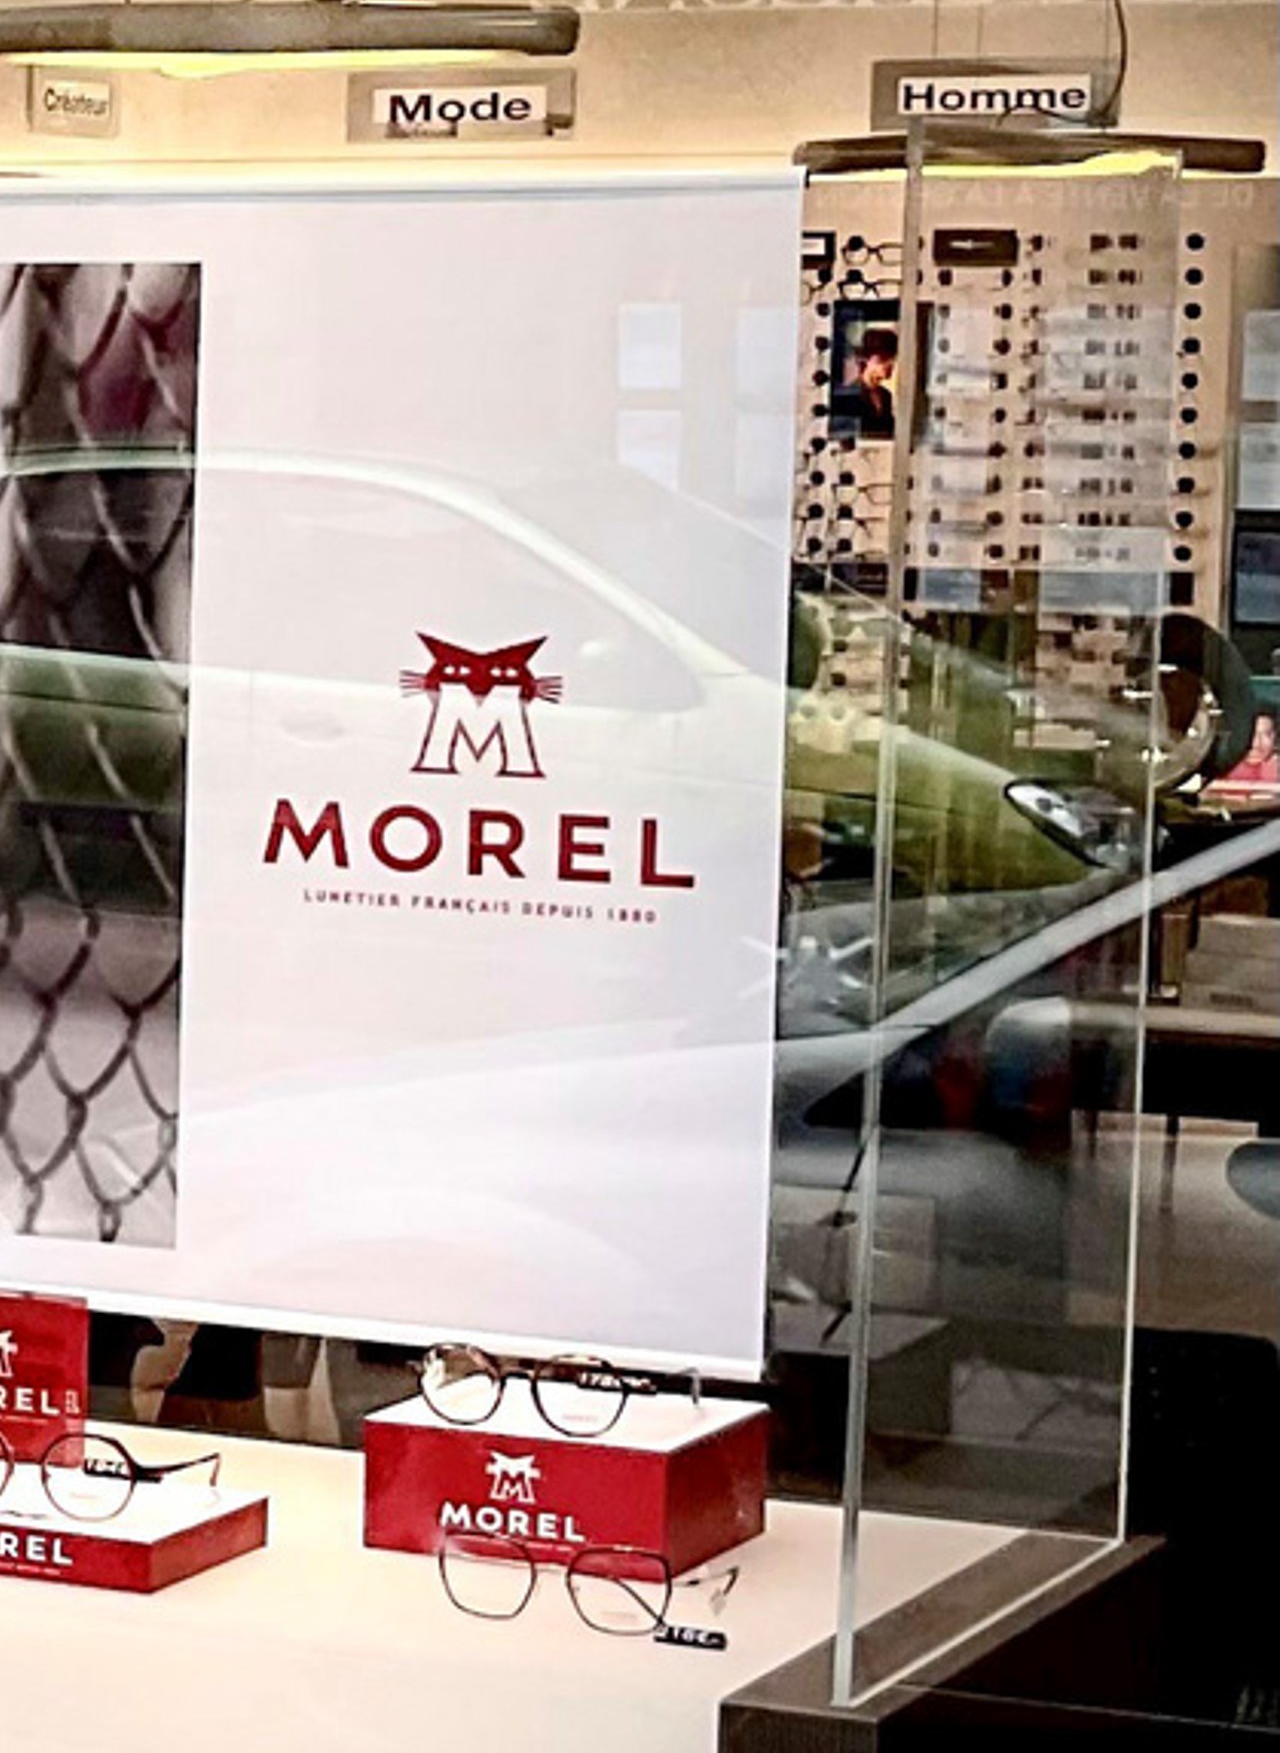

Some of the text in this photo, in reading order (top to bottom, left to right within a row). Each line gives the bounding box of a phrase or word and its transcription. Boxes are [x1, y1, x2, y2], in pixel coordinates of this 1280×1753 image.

[390, 91, 532, 123] Mode
[903, 83, 1086, 112] Homme
[262, 797, 697, 890] MOREL
[303, 889, 401, 908] LUNETIER
[410, 894, 512, 916] FRANÇAIS
[521, 901, 595, 920] DEPUIS
[439, 1500, 587, 1543] MOREL
